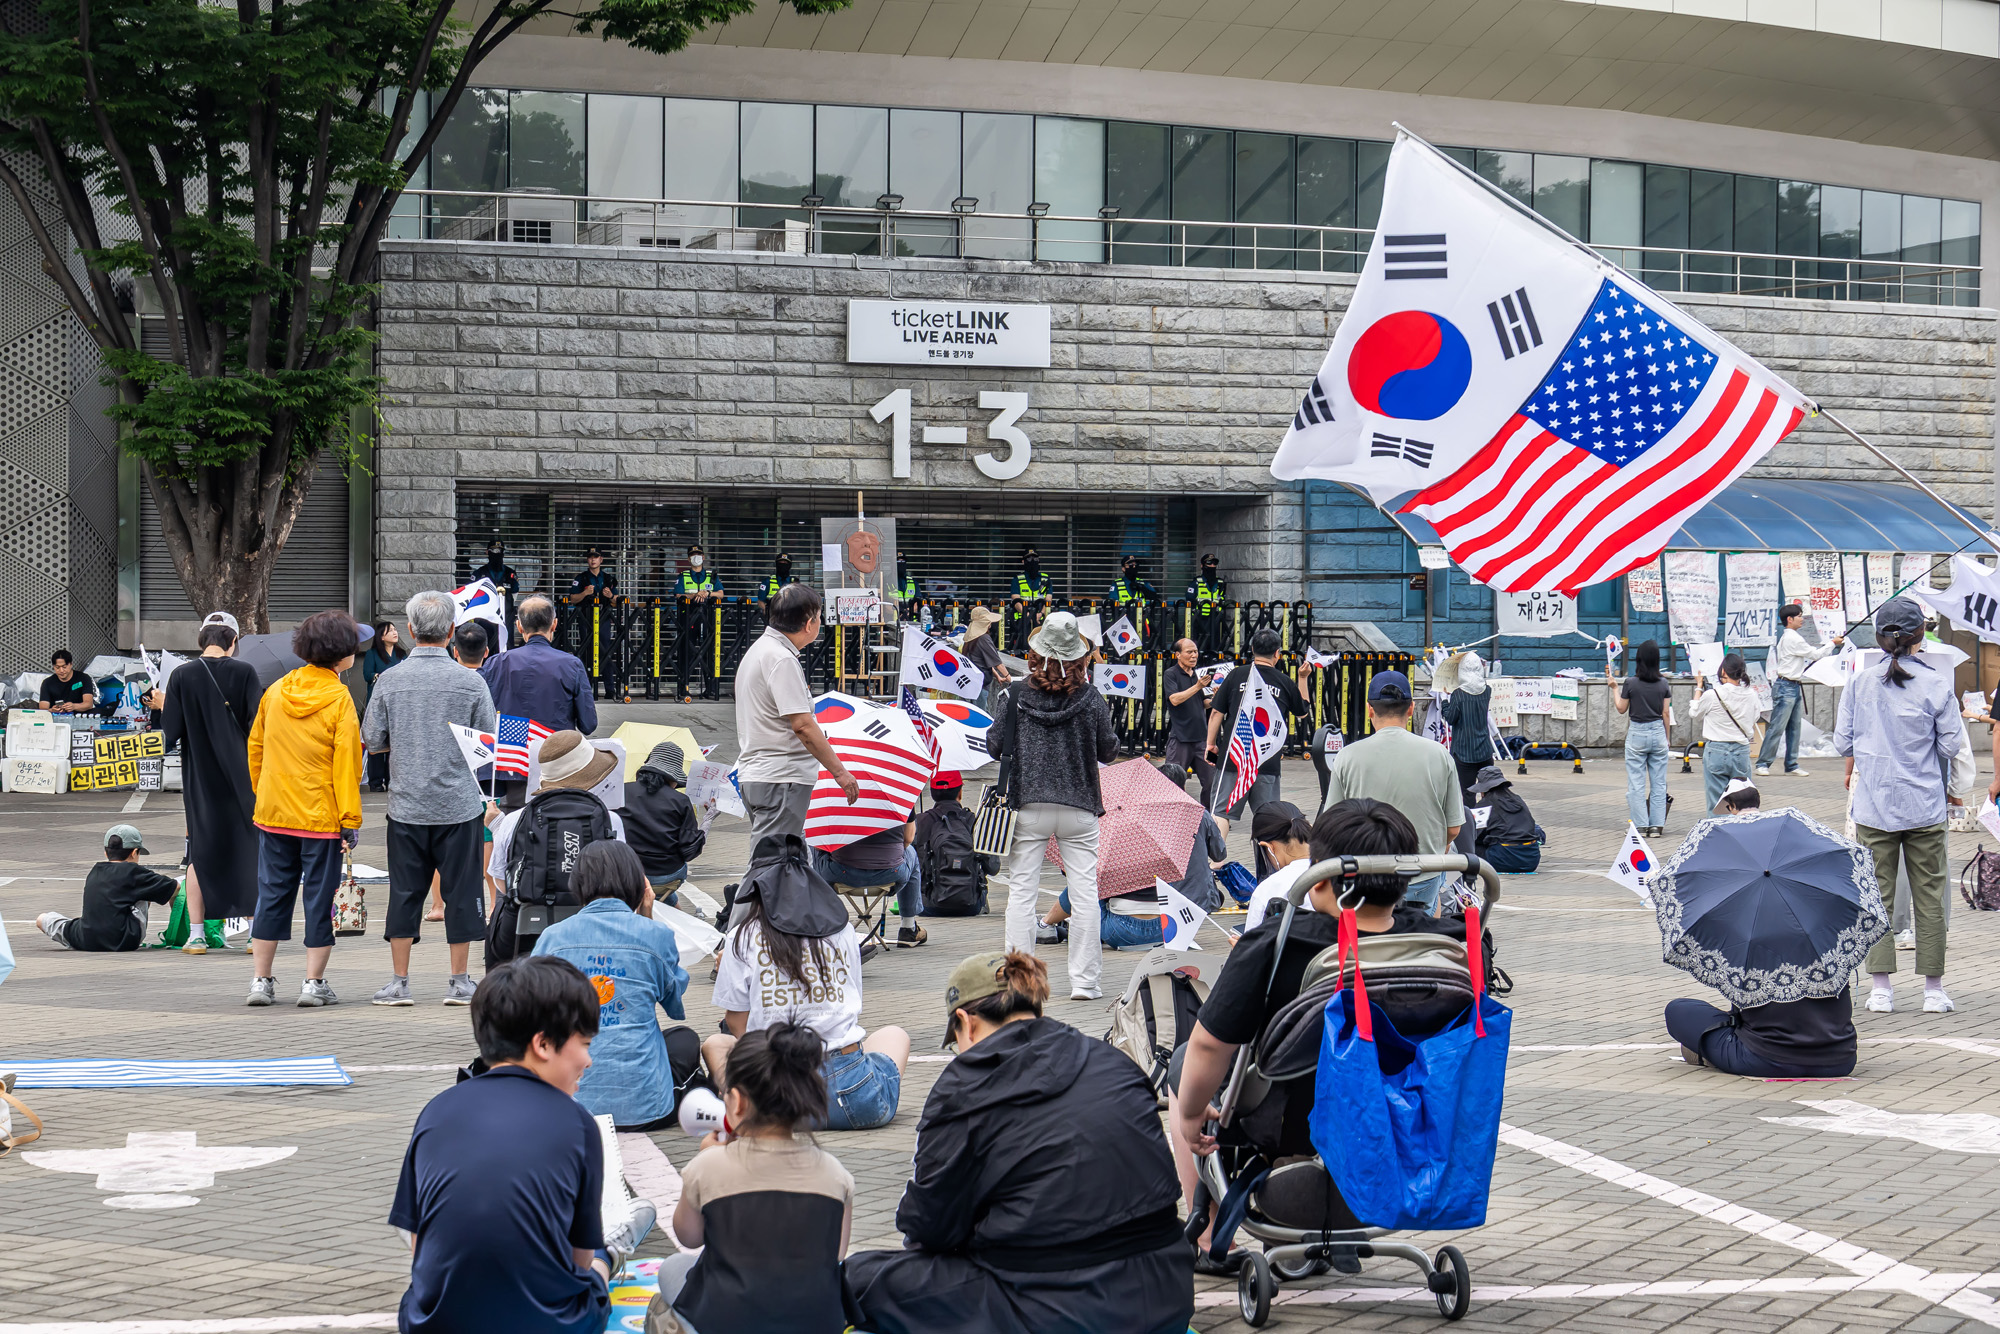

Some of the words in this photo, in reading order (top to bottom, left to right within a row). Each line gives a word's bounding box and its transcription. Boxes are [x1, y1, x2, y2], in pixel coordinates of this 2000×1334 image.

[891, 308, 1010, 330] ticketLINK
[903, 330, 939, 343] LIVE
[942, 331, 998, 345] ARENA
[928, 349, 950, 359] 핸드볼
[952, 350, 974, 359] 경기장
[868, 388, 1032, 480] 1-3
[1517, 600, 1563, 622] 재선거
[73, 733, 93, 744] 누가
[98, 736, 161, 759] 내란은
[73, 749, 93, 761] 봐도
[72, 762, 137, 788] 선관위
[140, 778, 160, 788] 하라
[762, 985, 844, 1008] EST.1969
